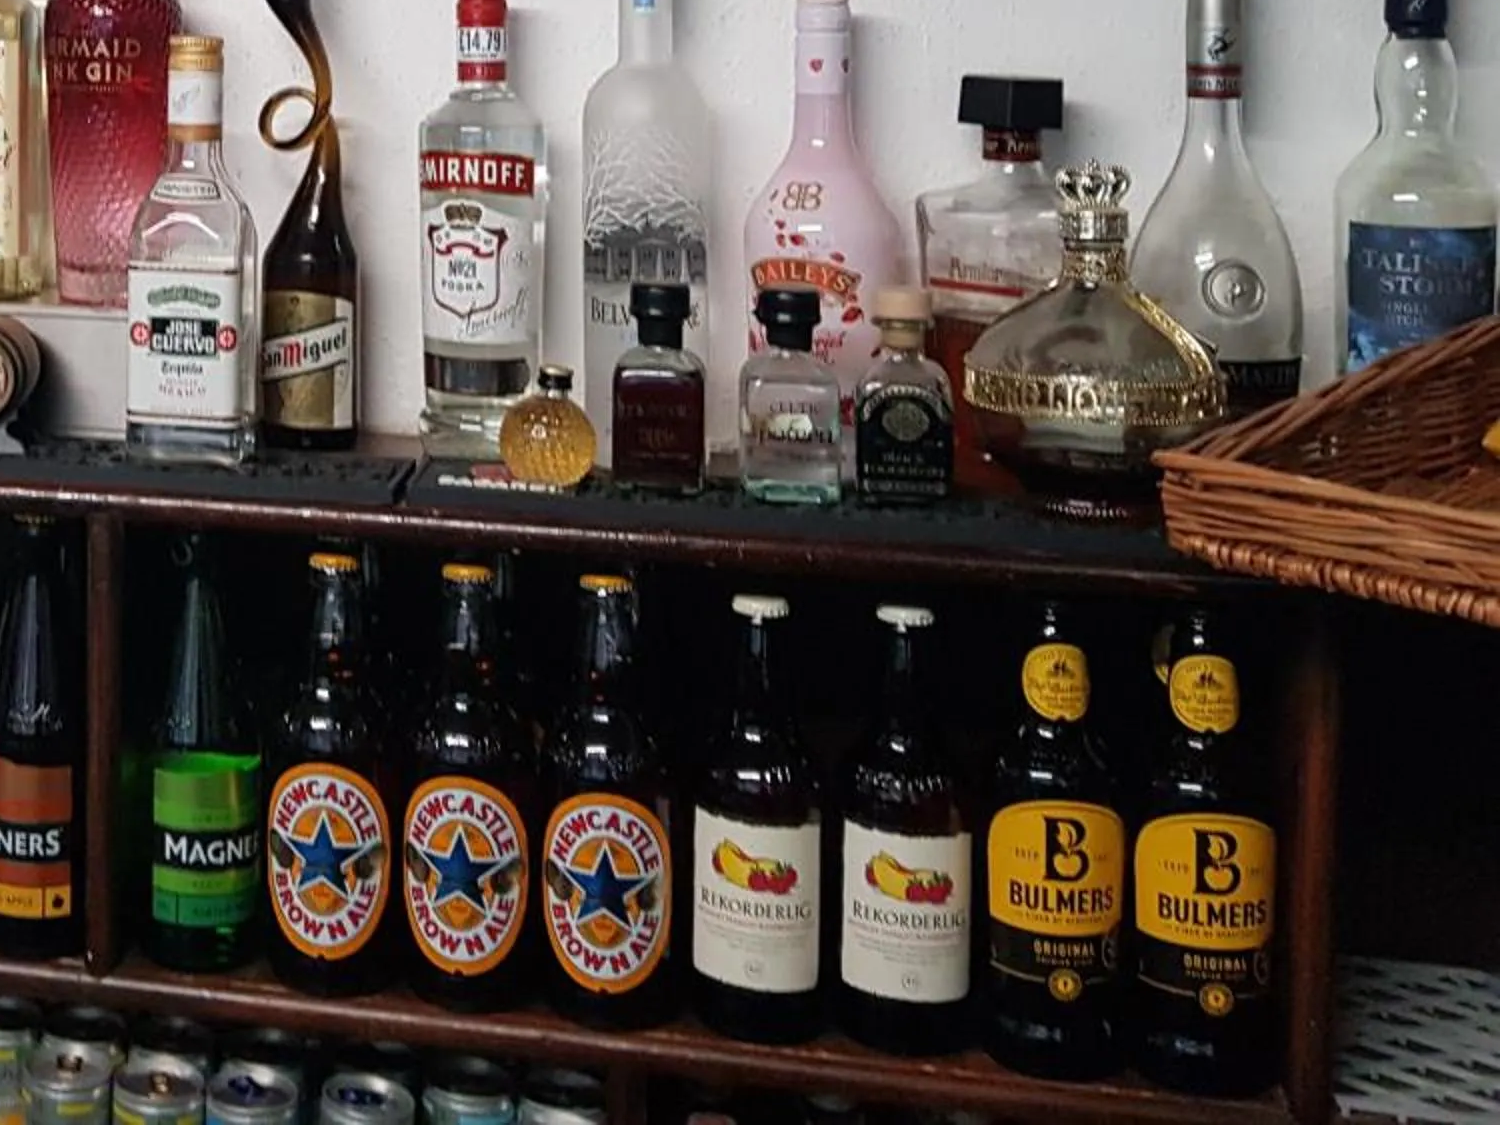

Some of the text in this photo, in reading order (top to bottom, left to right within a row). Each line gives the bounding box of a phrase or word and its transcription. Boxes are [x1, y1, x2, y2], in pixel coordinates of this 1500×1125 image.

[85, 61, 136, 84] GIN
[756, 261, 847, 294] BAILEYS
[275, 778, 379, 842] NEWCASTLE
[410, 793, 518, 856] NEWCASTLE
[551, 809, 661, 875] NEWCASTLE
[275, 873, 378, 940] BROWN ALE
[701, 886, 812, 922] REKORDERLIG
[852, 898, 967, 932] REKORDERLIG
[1008, 878, 1114, 915] BULMERS
[1157, 892, 1267, 930] BULMERS
[410, 885, 515, 956] BROWN ALE
[552, 903, 661, 974] BROWN ALE
[1033, 938, 1095, 957] ORIGINAL
[1183, 953, 1248, 972] ORIGINAL
